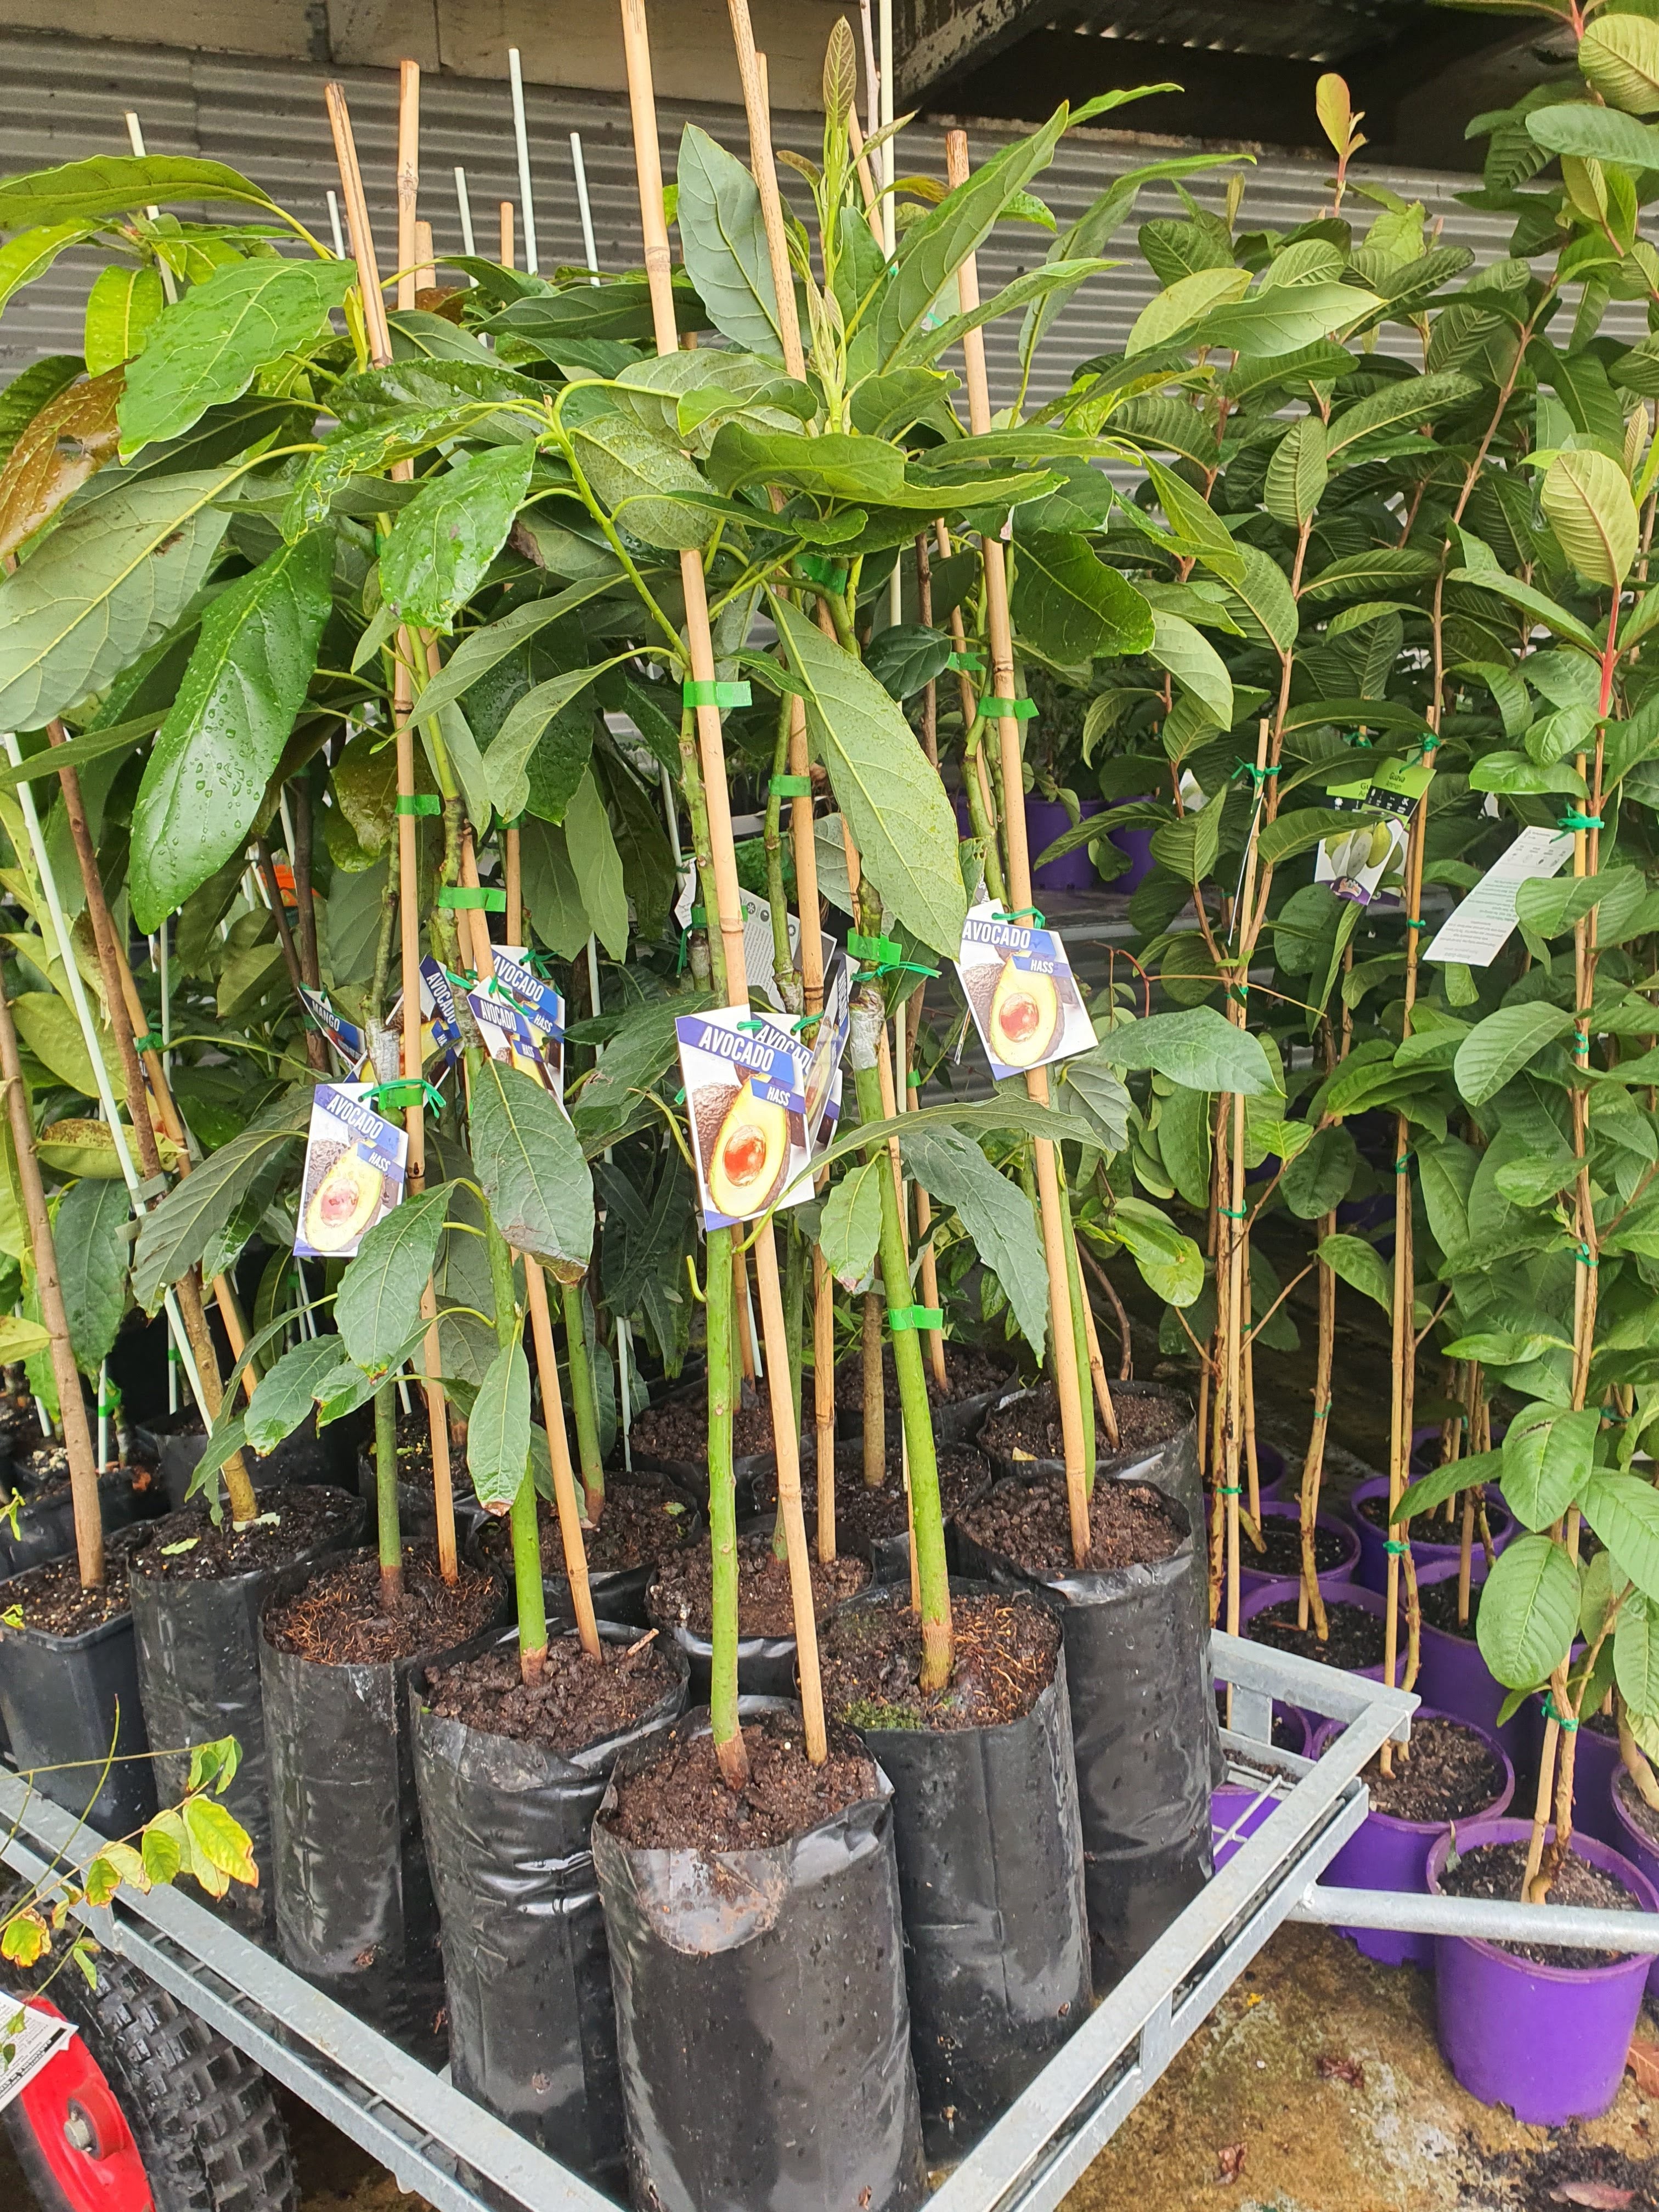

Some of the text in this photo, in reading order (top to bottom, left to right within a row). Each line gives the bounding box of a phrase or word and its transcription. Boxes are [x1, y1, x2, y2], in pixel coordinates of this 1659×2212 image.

[962, 921, 1031, 949] AVOCADO
[494, 955, 544, 1002] AVOCADO
[1030, 959, 1054, 974] HASS
[426, 972, 456, 1024] AVOCADO
[312, 1000, 340, 1031] MANGO
[481, 1000, 517, 1031] AVOCADO
[534, 1014, 553, 1033] HASS
[437, 1034, 447, 1047] HA
[522, 1043, 535, 1058] HASS
[698, 1026, 775, 1072] AVOCADO
[766, 1086, 791, 1107] HASS
[326, 1094, 384, 1139] AVOCADO
[369, 1152, 391, 1172] HASS
